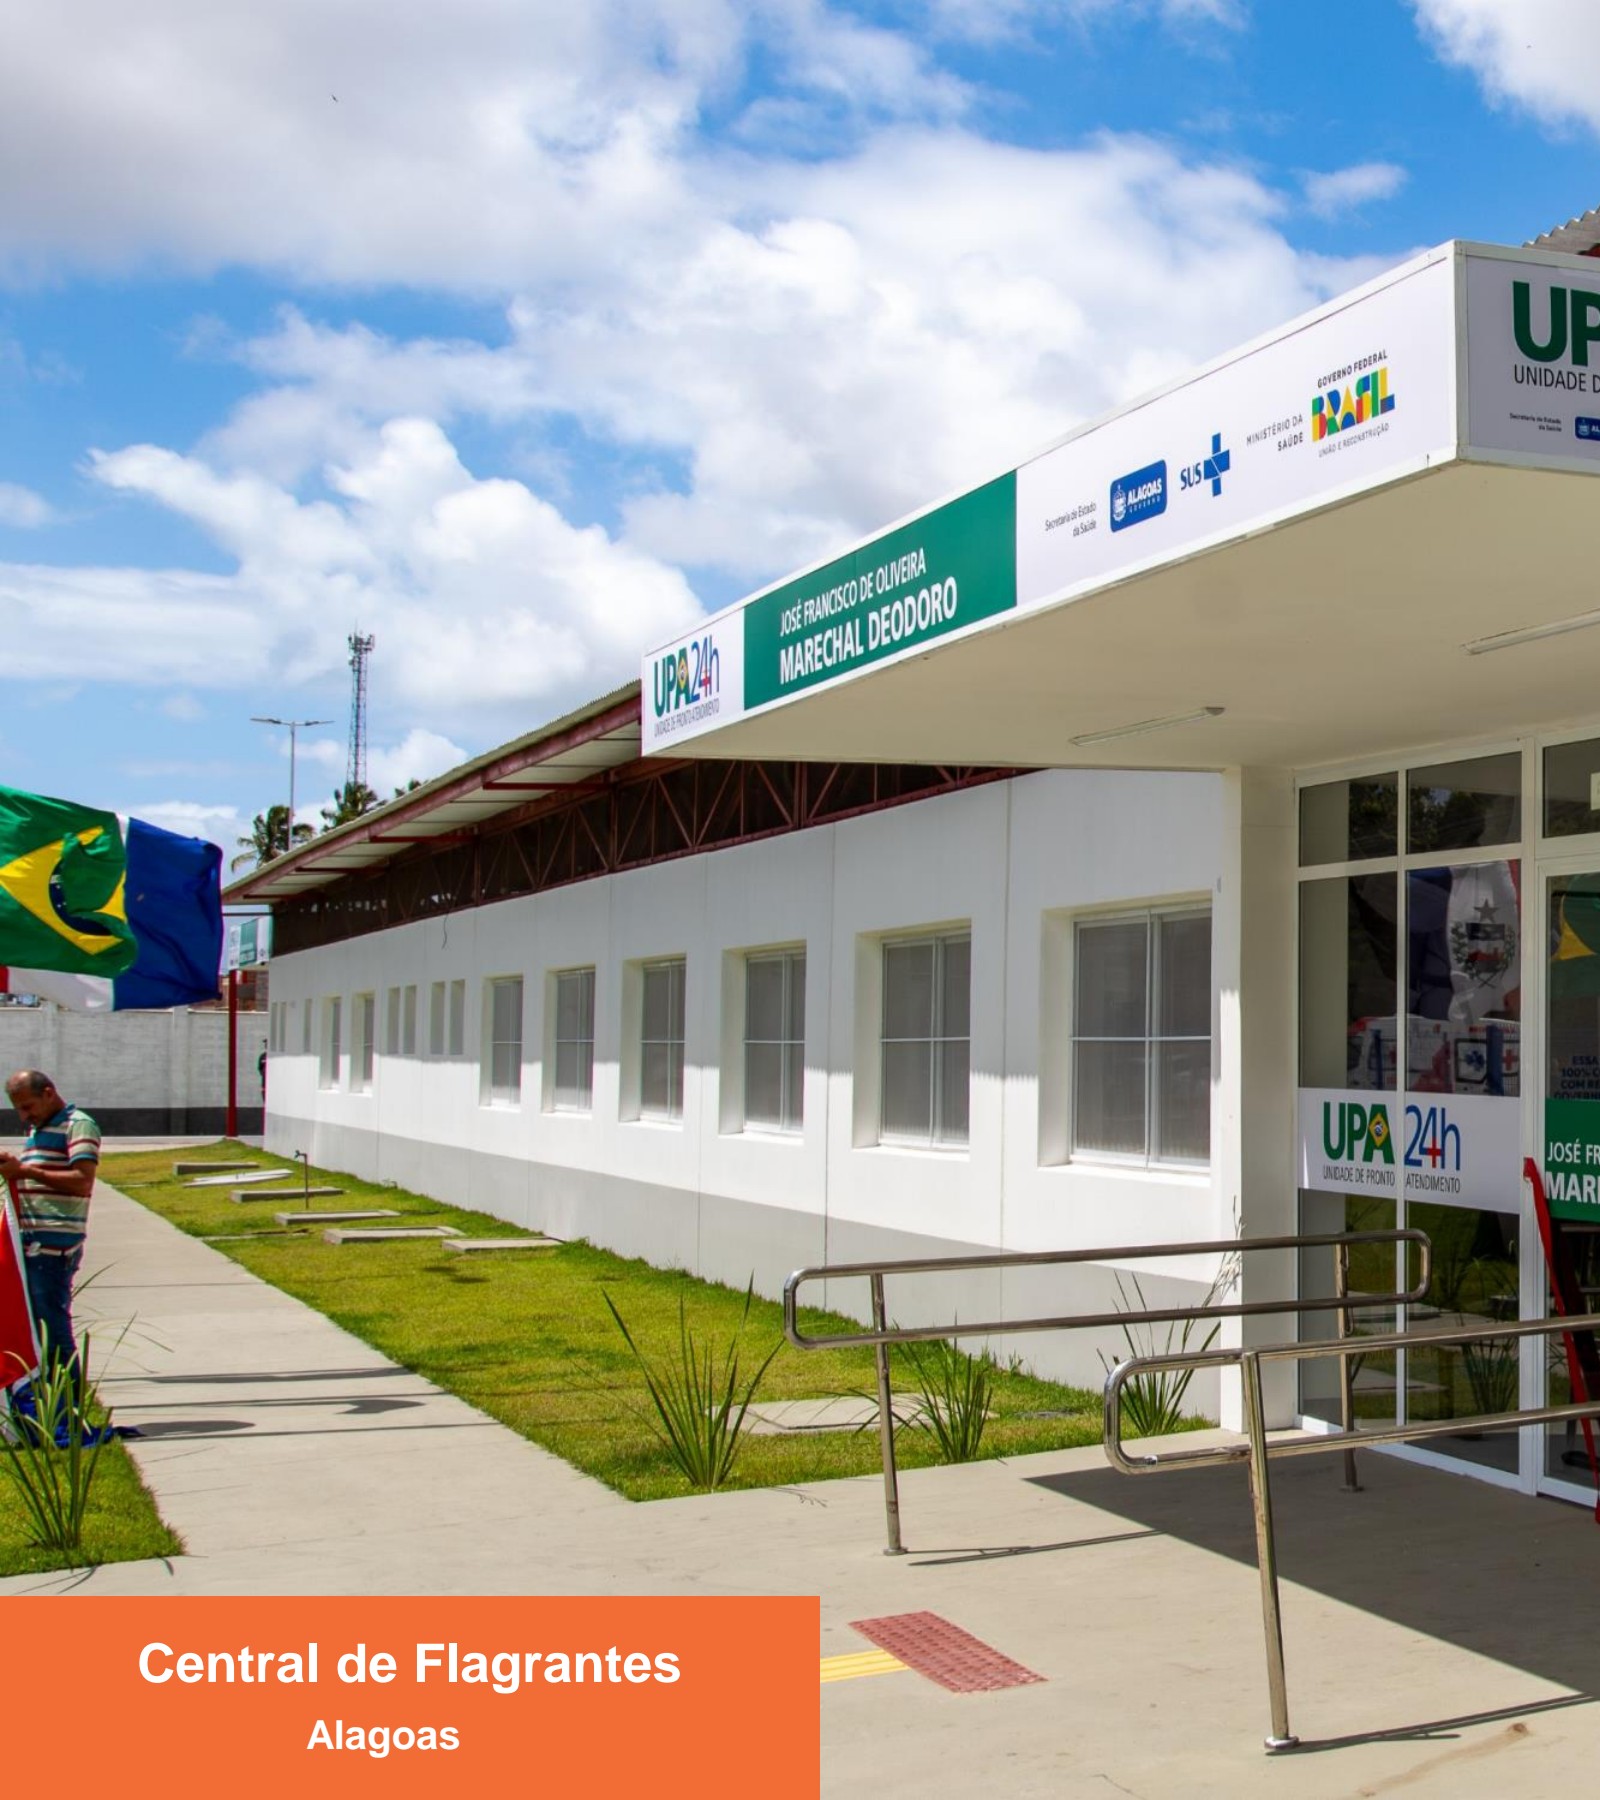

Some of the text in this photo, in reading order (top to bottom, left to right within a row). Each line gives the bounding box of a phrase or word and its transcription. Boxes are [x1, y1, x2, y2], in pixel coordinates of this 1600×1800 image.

[1318, 349, 1388, 388] GOVERNO FEDERAL
[1514, 363, 1586, 393] UNIDADE
[1312, 367, 1395, 442] BRASIL
[1246, 413, 1303, 446] MINISTÉRIO DA
[1278, 431, 1304, 451] SAÚDE
[1338, 440, 1342, 451] E
[1343, 422, 1389, 448] RECONSTRUÇÃO
[1180, 462, 1202, 491] SUS
[1127, 477, 1162, 506] ALAGOAS
[1045, 511, 1071, 531] Secretaria
[1078, 502, 1096, 518] Estado
[1080, 519, 1096, 534] Saúde
[780, 547, 926, 637] JOSÉ FRANCISCO DE OLIVEIRA
[780, 576, 957, 685] MARECHAL DEODORO
[654, 635, 719, 718] UPA 24h
[1323, 1101, 1461, 1171] UPA 24h
[1547, 1138, 1581, 1163] JOSÉ
[1324, 1165, 1461, 1194] UNIDADE DE PRONTO ATENDIMENTO
